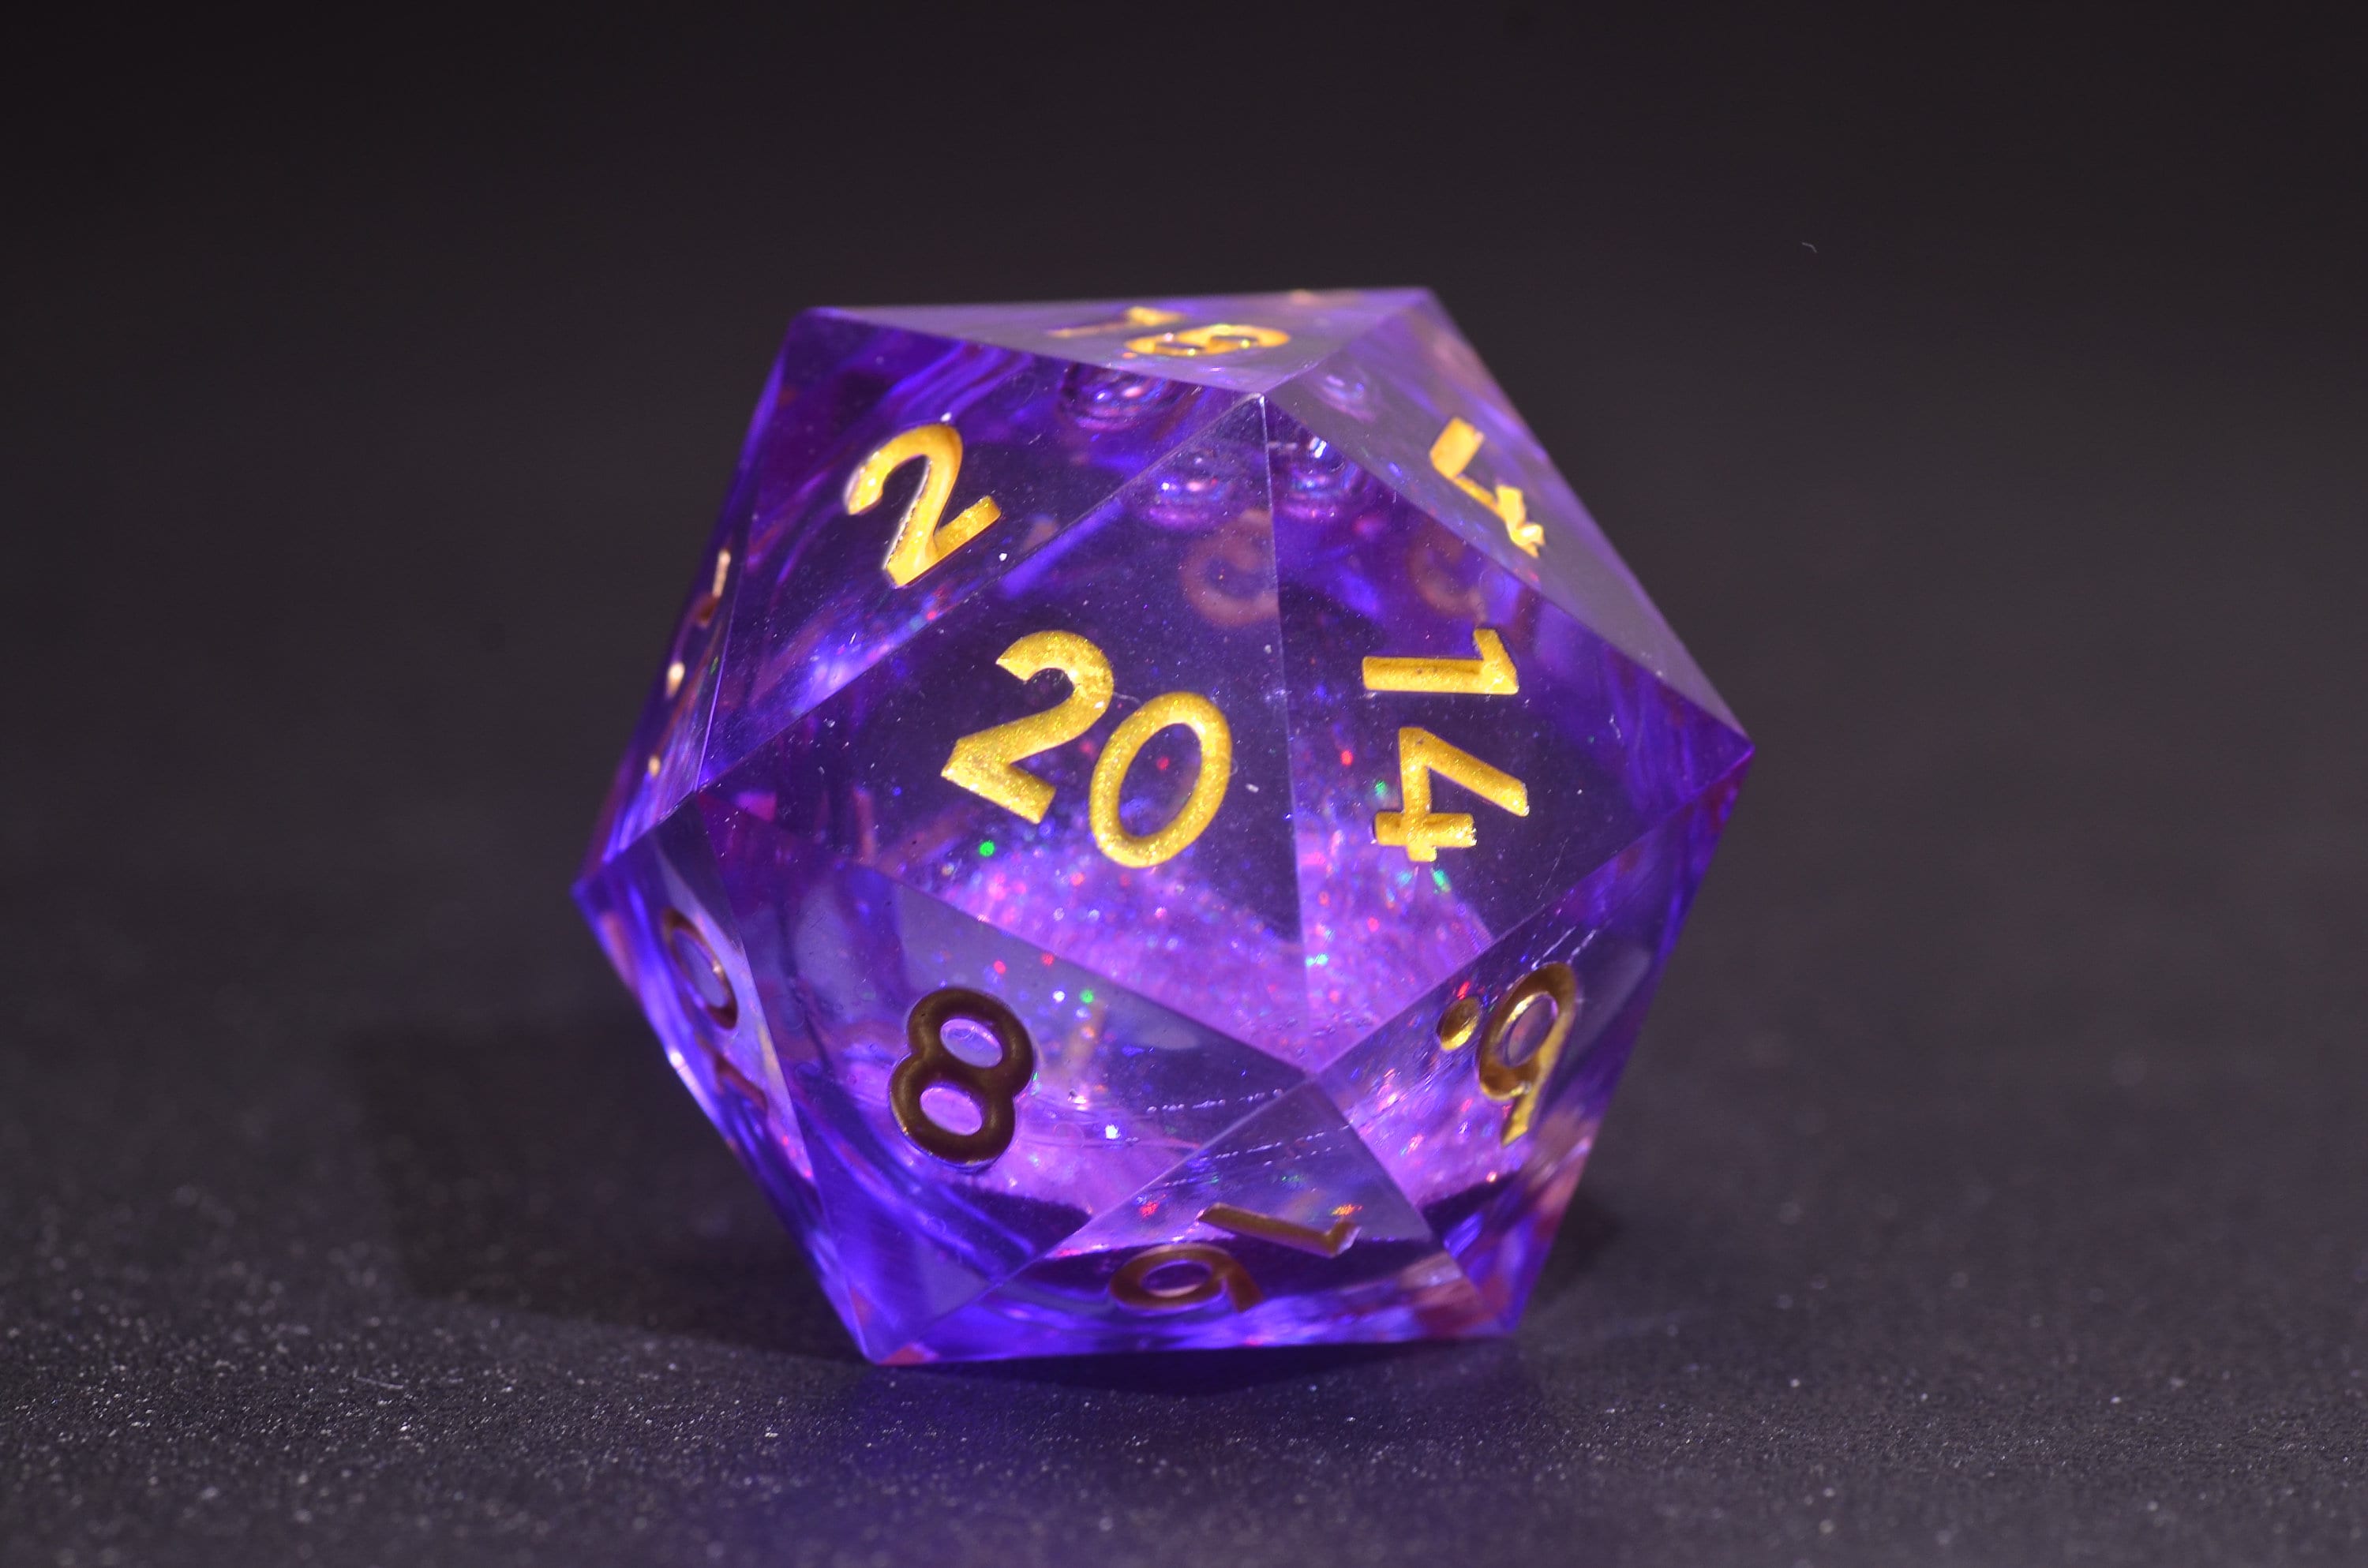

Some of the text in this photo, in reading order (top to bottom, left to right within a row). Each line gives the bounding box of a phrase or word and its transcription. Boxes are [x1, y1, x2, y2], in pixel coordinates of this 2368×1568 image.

[845, 421, 1002, 588] 2
[941, 630, 1233, 868] 20
[1361, 628, 1529, 863] 14
[889, 986, 1036, 1167] 8
